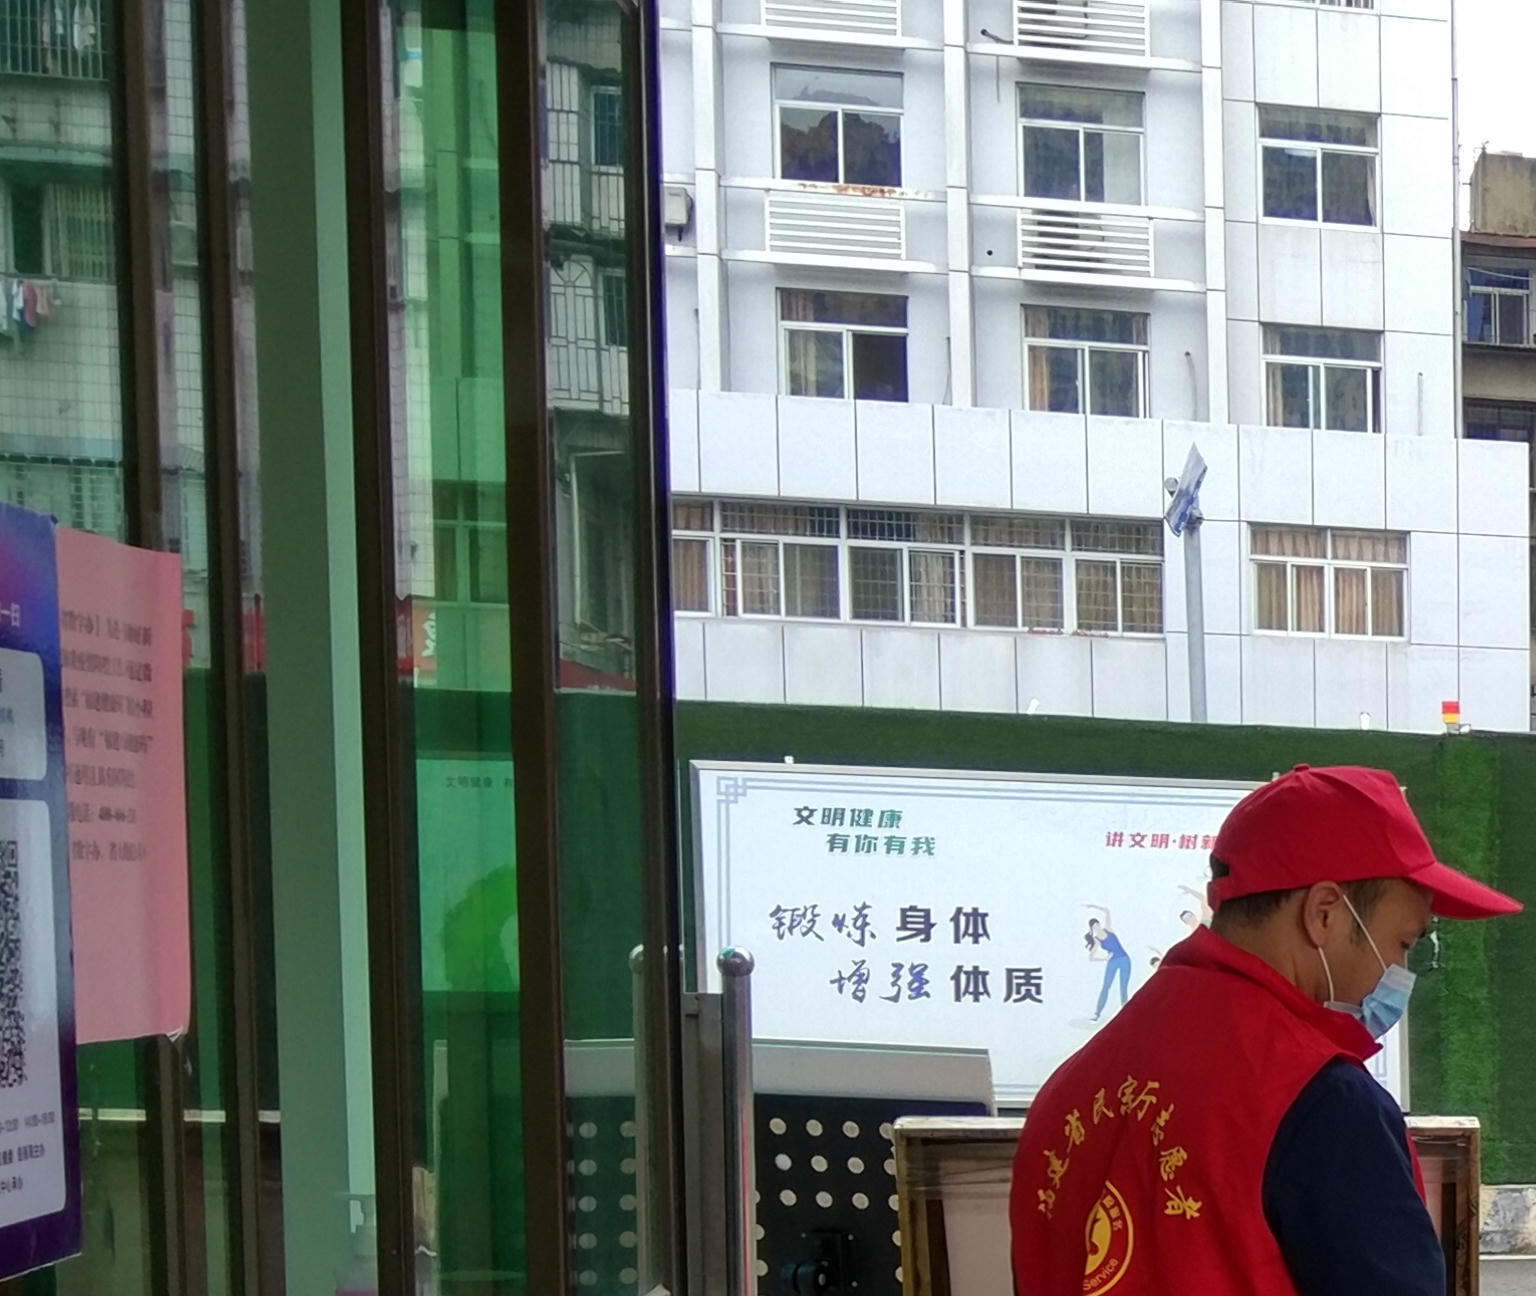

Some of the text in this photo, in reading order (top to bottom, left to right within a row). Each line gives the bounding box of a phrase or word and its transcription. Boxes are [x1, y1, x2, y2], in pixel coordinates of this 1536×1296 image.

[793, 806, 903, 829] 文明健康
[826, 833, 936, 856] 有你有我
[769, 900, 991, 948] 锻炼身体
[830, 959, 1044, 1004] 增强体质
[1082, 1257, 1119, 1291] Service
